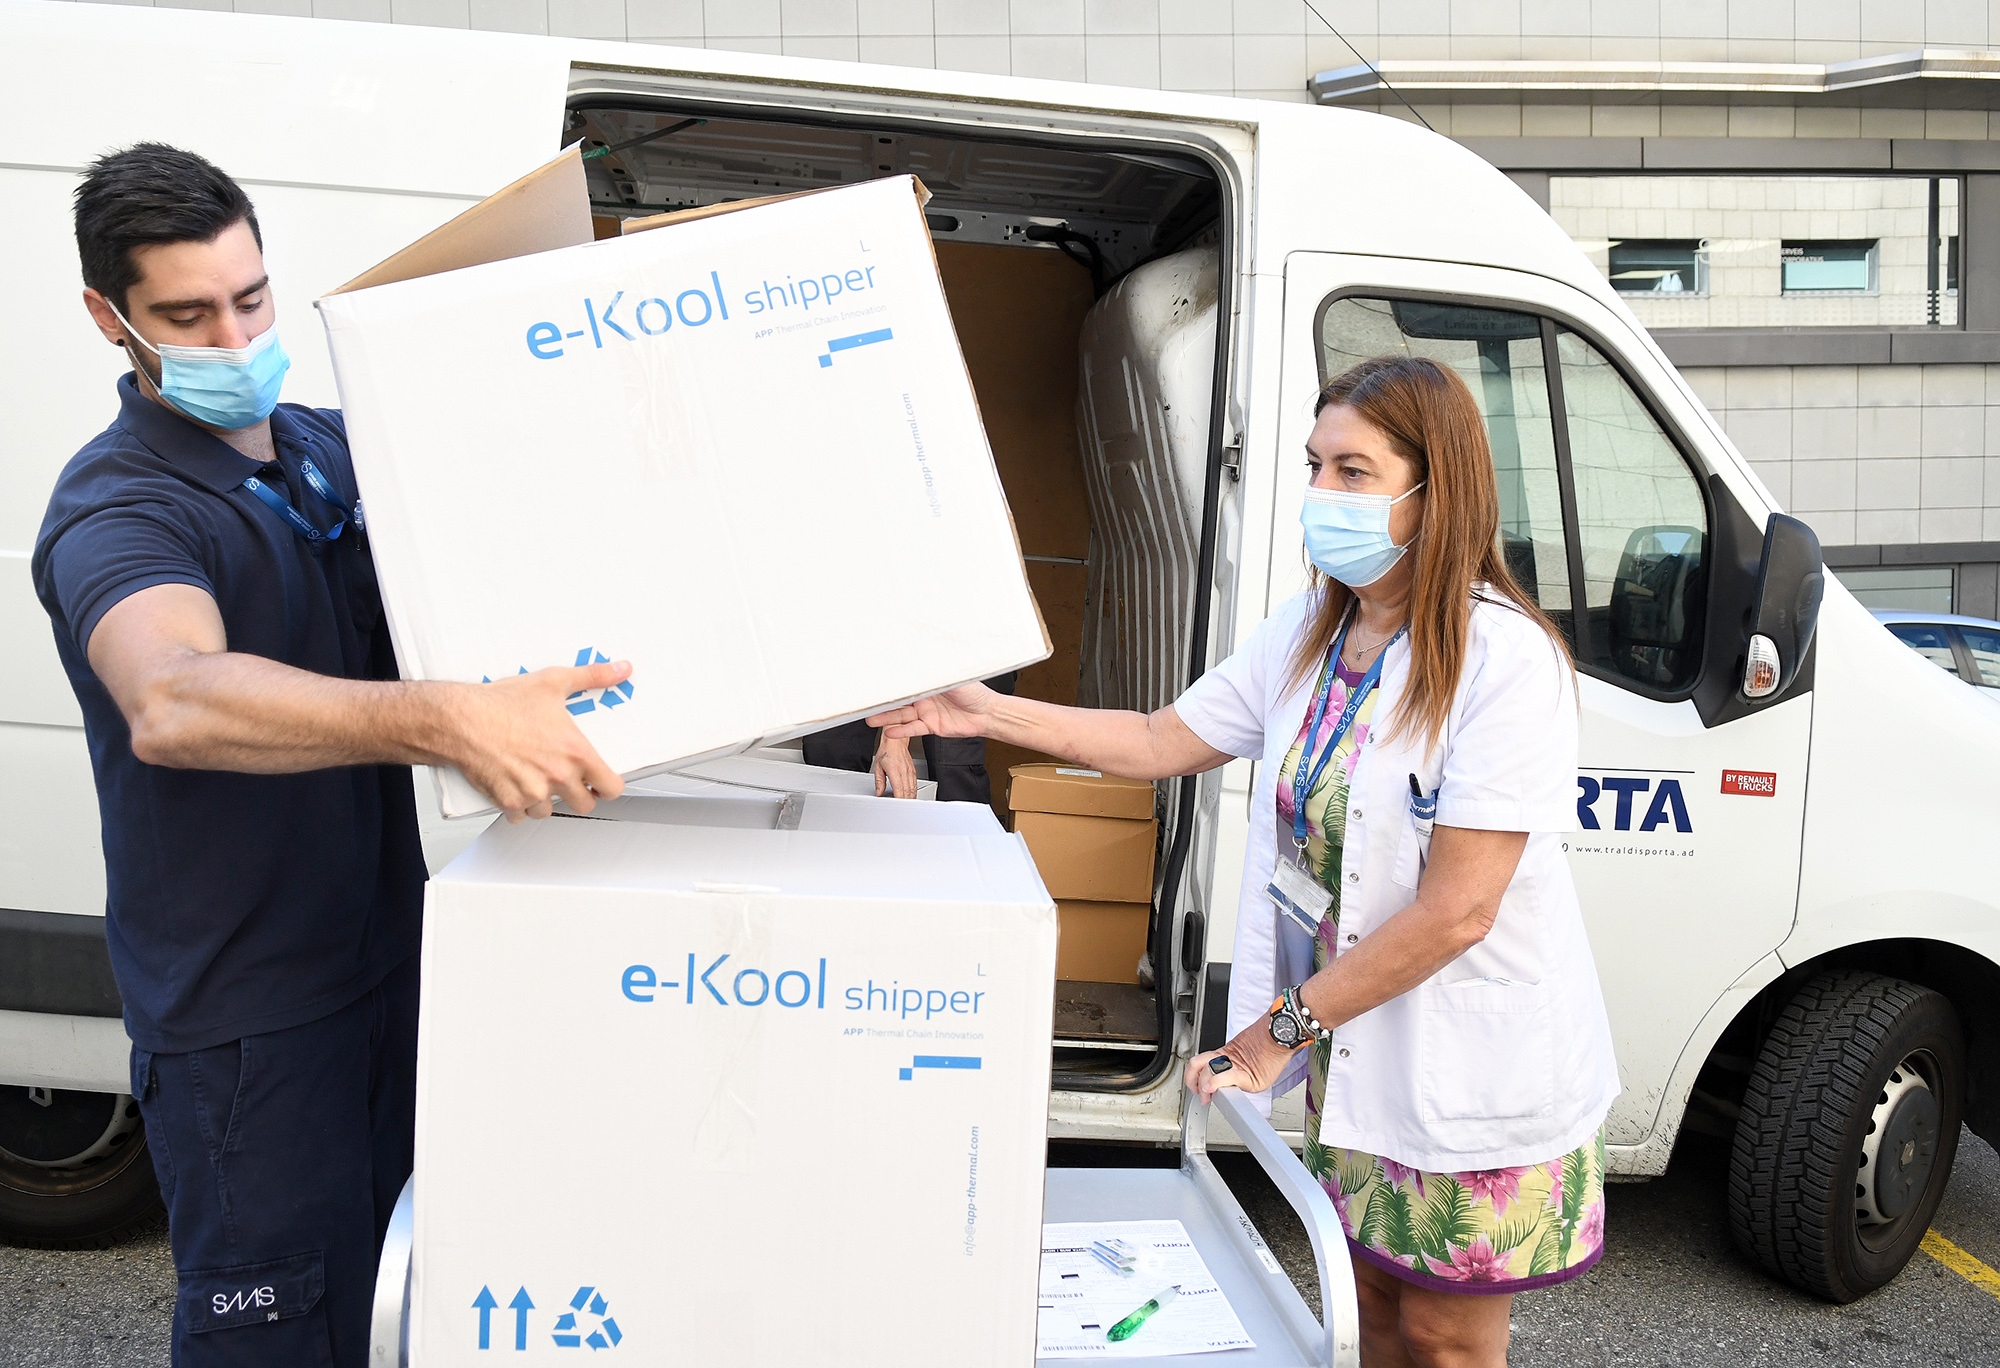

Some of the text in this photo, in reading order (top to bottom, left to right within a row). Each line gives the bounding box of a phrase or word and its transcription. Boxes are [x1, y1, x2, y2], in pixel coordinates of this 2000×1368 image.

[1781, 247, 1804, 256] ERVEIS
[1781, 255, 1824, 264] ORPORATIUS
[525, 265, 876, 360] e-Kool shipper
[754, 304, 888, 340] APP Thermal Chain Innovation
[1726, 774, 1774, 785] BY RENAULT
[1738, 782, 1774, 792] TRUCKS
[1577, 776, 1693, 833] RTA
[1576, 846, 1695, 857] www.traldisporta.ad
[621, 953, 985, 1020] e-Kool shipper
[843, 1028, 984, 1040] APP Thermal Chain Innovation
[963, 1125, 979, 1257] info@app-thermal.com
